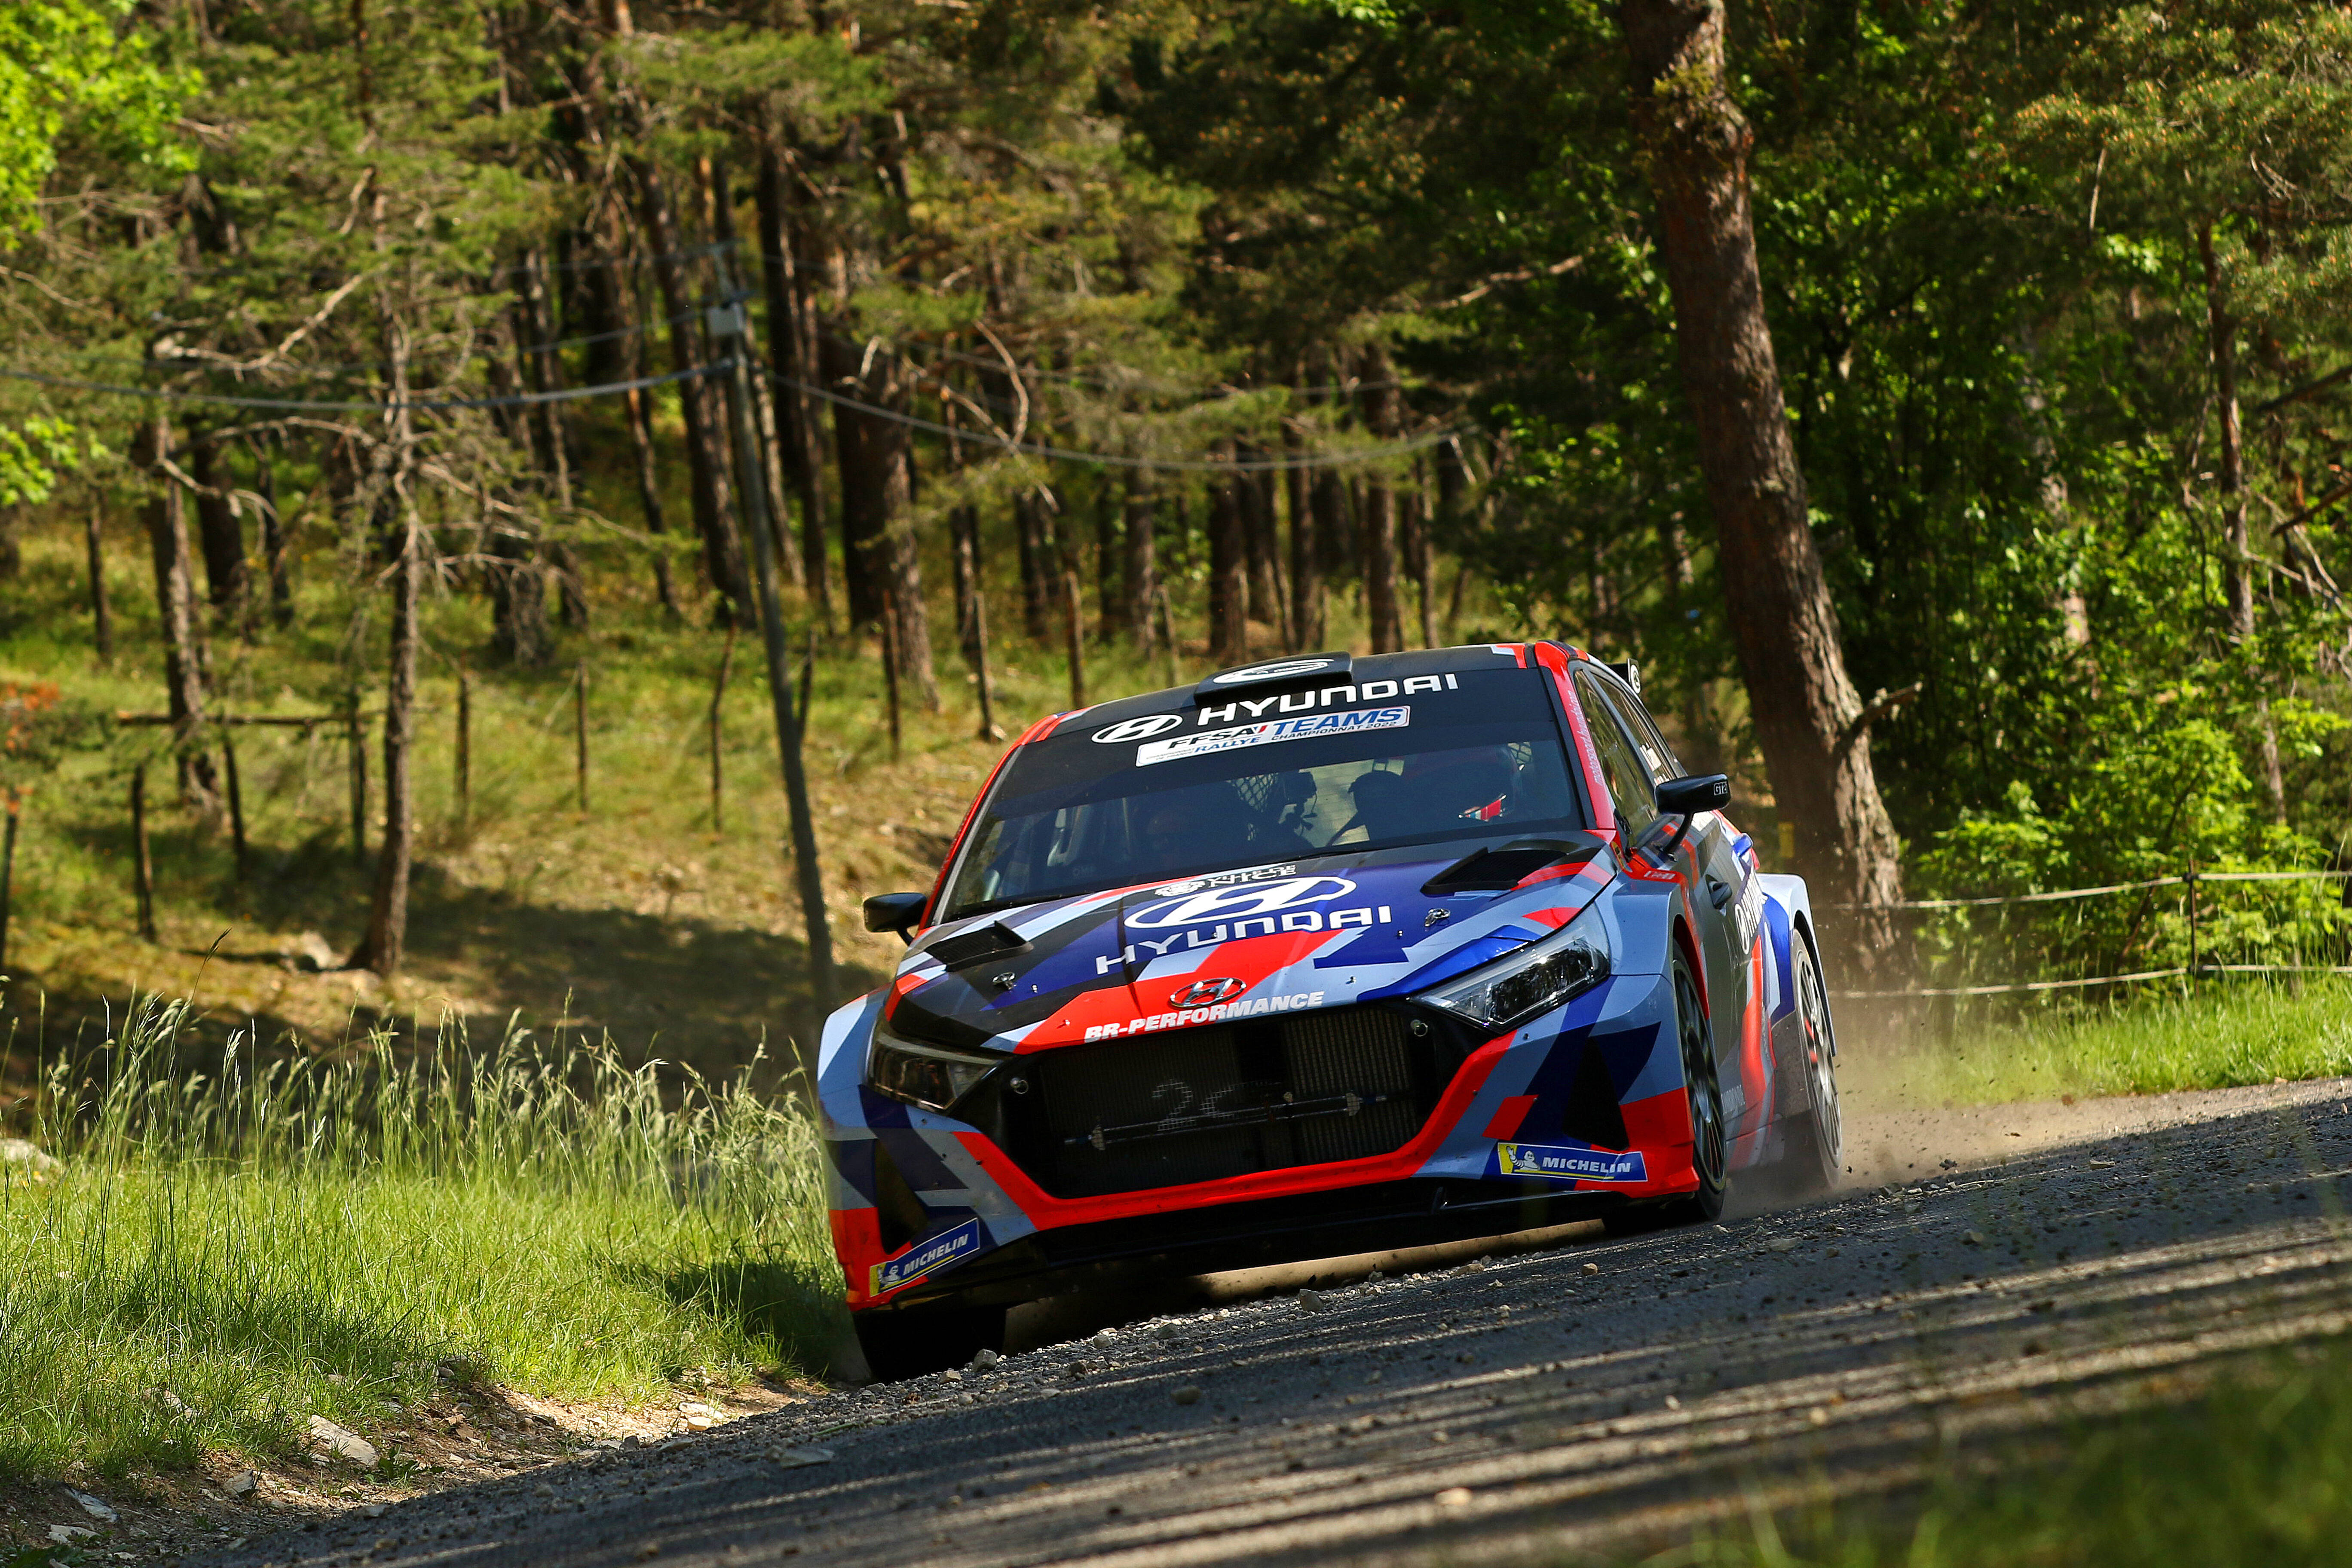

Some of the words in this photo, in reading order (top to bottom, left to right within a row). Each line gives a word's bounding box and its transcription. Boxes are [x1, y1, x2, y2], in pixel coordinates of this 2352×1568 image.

[1197, 674, 1458, 726] HYUNDAI
[1167, 728, 1254, 749] FFSA
[1273, 707, 1403, 735] TEAMS
[1194, 736, 1262, 753] RALLYE
[1271, 725, 1364, 741] CHAMPIONNAT
[1366, 721, 1396, 729] 2022
[1096, 906, 1392, 975] HYUNDAI
[1084, 991, 1325, 1044] BR-PERFORMANCE
[1542, 1157, 1631, 1173] MICHELIN
[903, 1234, 969, 1276] MICHELIN
